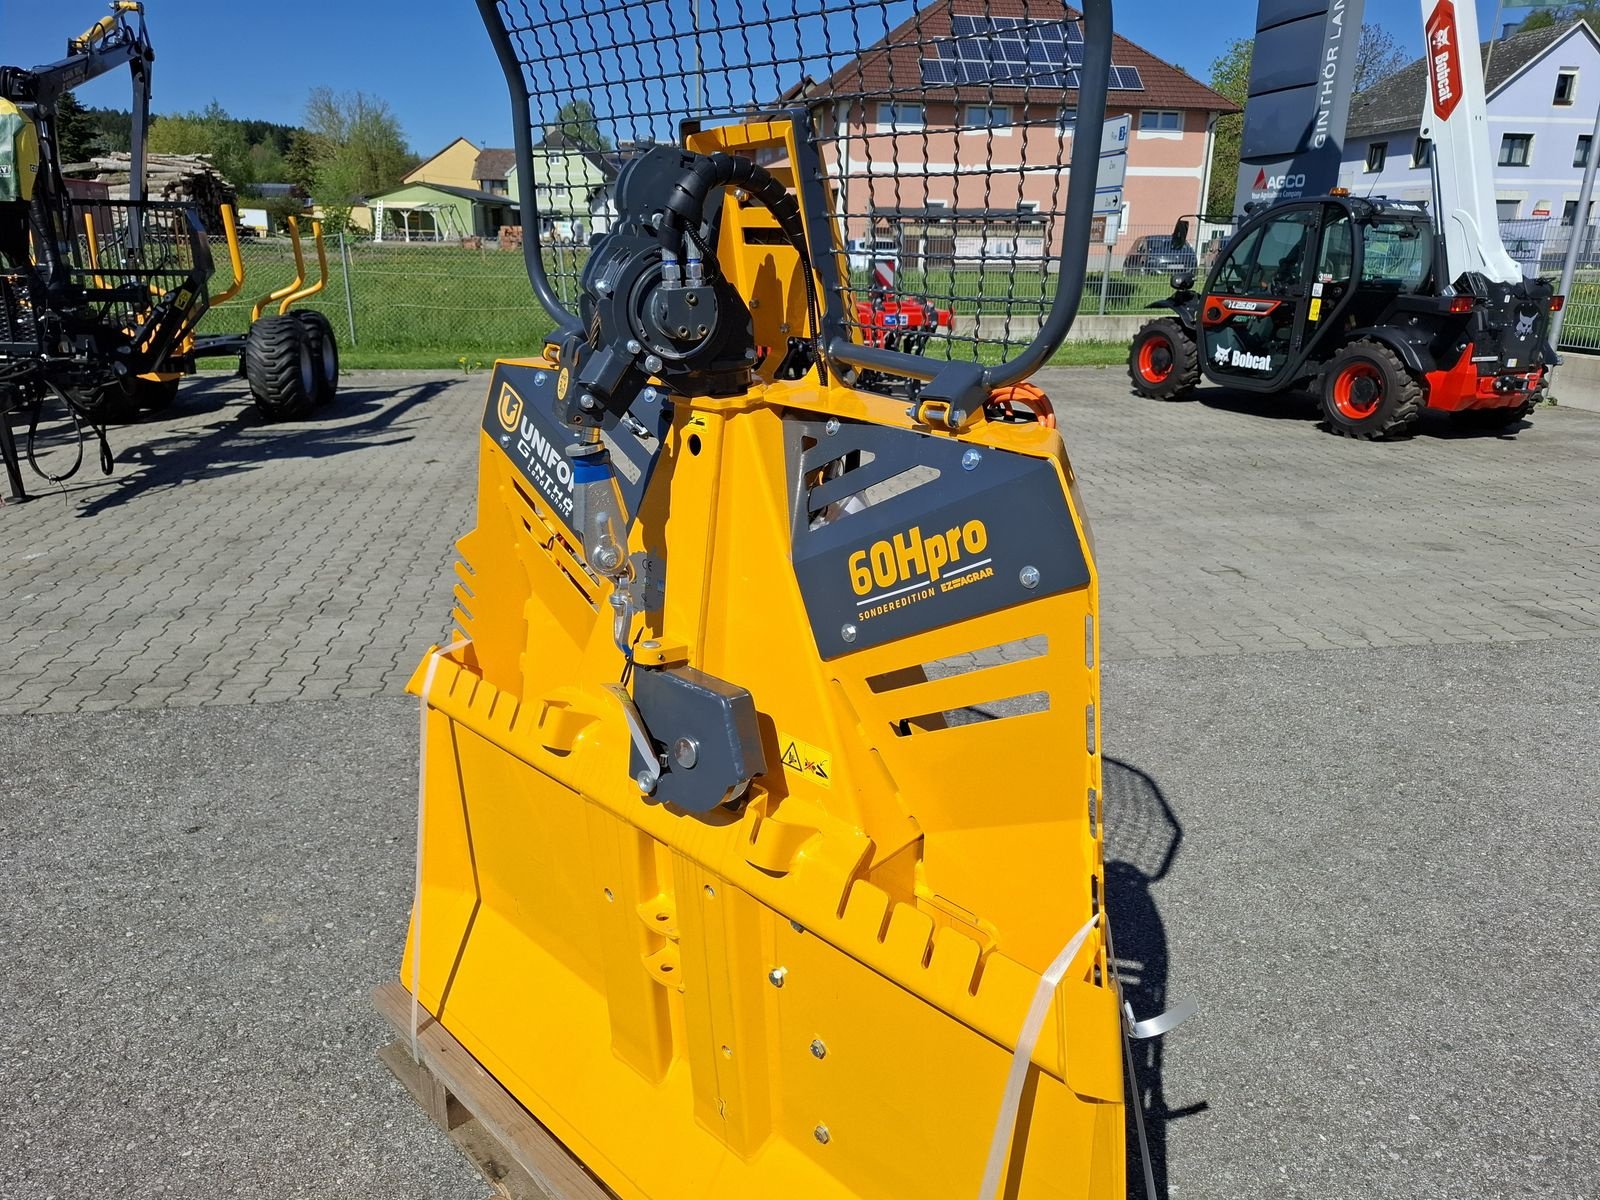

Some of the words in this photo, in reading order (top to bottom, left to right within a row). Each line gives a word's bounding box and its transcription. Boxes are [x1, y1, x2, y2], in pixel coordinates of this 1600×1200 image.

[1314, 46, 1339, 149] GINTHÖR
[1435, 50, 1453, 105] Bobcat
[1266, 173, 1306, 190] AGCO
[1231, 349, 1273, 371] Bobcat
[526, 463, 571, 518] Landtechnik
[848, 519, 988, 596] 60Hpro
[858, 587, 936, 622] SONDEREDITION
